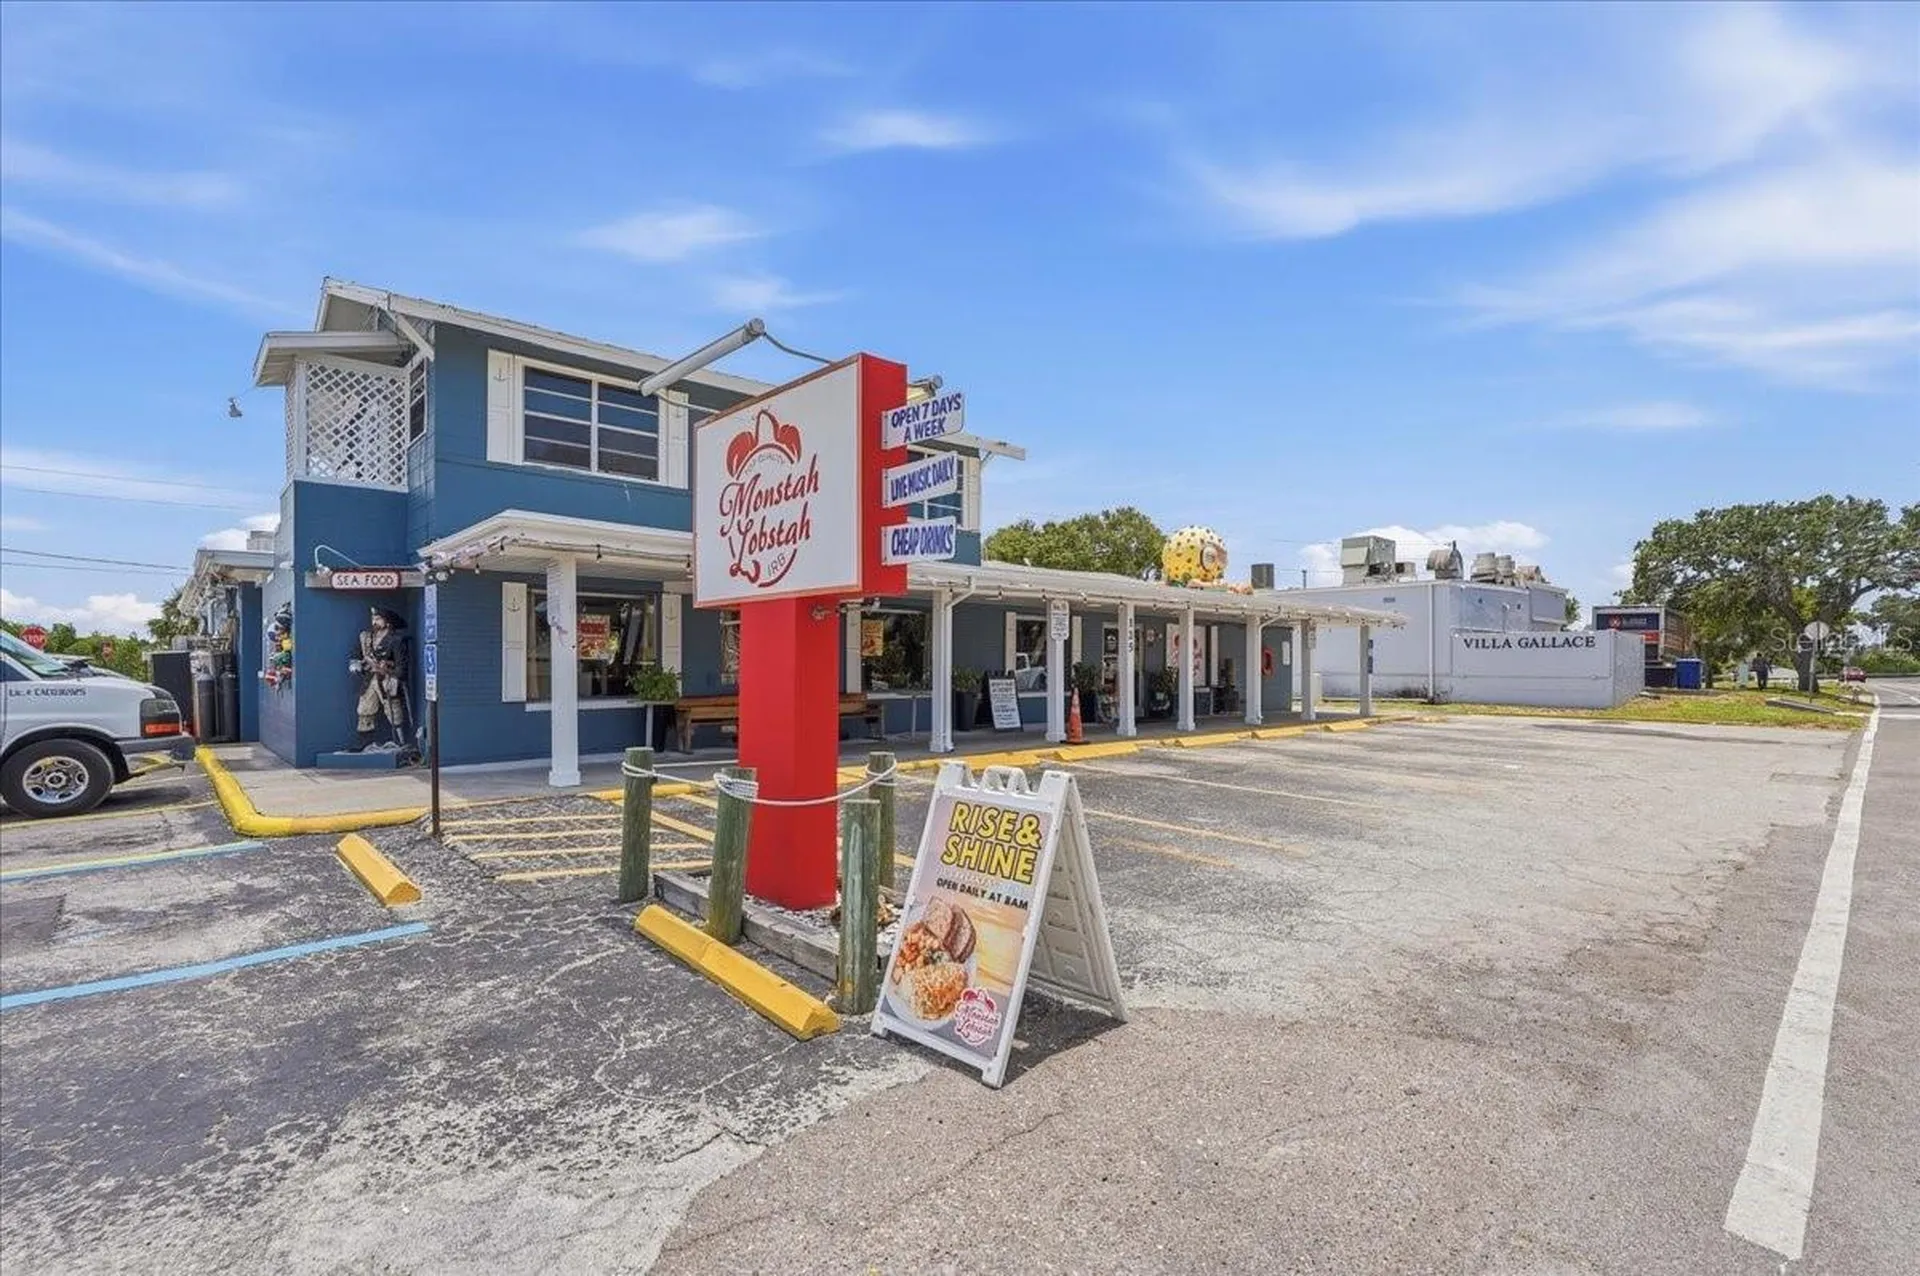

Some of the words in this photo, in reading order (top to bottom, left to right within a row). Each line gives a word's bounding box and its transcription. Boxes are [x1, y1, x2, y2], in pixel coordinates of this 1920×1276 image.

[891, 406, 920, 428] OPEN
[922, 404, 930, 420] 7
[932, 393, 962, 416] DAYS
[903, 426, 912, 442] A
[914, 417, 946, 439] WEEK
[719, 453, 819, 536] Monstah
[891, 476, 908, 502] LIVE
[908, 465, 932, 496] MUSIC
[933, 456, 955, 486] DAILY
[731, 501, 811, 574] Lobstah
[891, 527, 919, 556] CHEAP
[920, 524, 954, 555] DRINKS
[336, 575, 358, 586] SEA
[364, 575, 394, 586] FOOD
[767, 552, 787, 577] IRB
[1464, 637, 1512, 649] VILLA
[1517, 636, 1596, 649] GALLACE
[940, 834, 1038, 885] SHINE
[936, 878, 958, 891] OPEN
[959, 884, 987, 898] DAILY
[988, 892, 1002, 903] AT
[1004, 895, 1029, 910] 8AM
